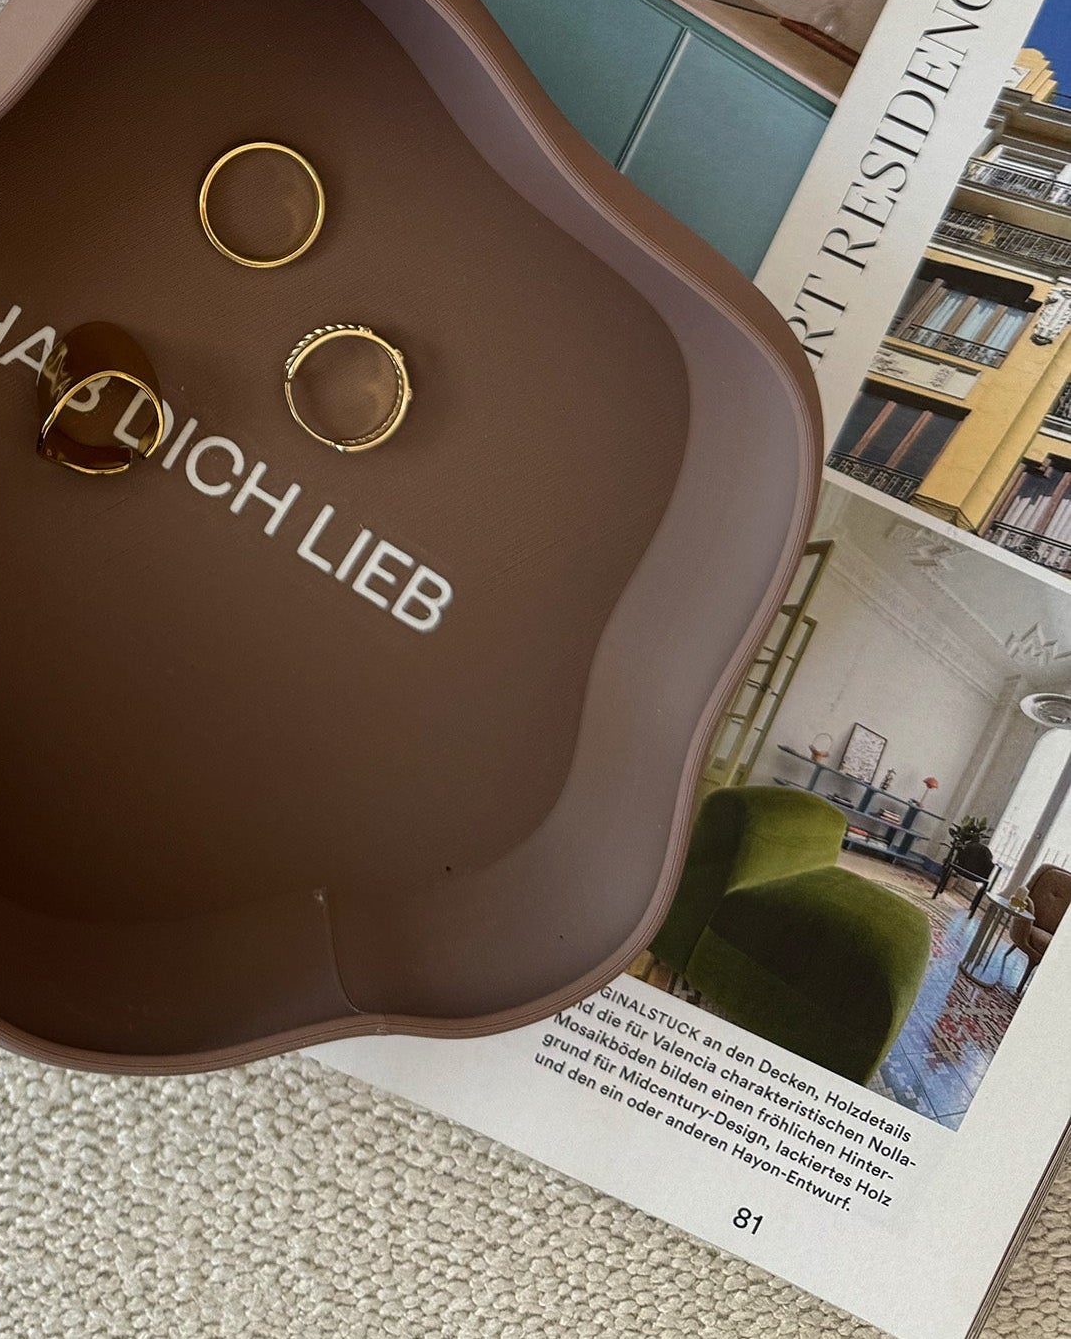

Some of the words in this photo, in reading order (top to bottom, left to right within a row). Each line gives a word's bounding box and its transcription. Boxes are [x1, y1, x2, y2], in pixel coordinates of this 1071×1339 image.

[786, 272, 849, 373] RT
[113, 389, 301, 536] DICH
[297, 504, 454, 632] LIEB
[534, 1052, 566, 1074] und
[567, 1067, 597, 1090] den
[599, 1084, 624, 1102] ein
[626, 1097, 664, 1120] oder
[664, 1115, 728, 1152] anderen
[730, 1142, 851, 1212] Hayon-Entwurf.
[541, 1033, 592, 1062] grund
[592, 1053, 617, 1074] für
[618, 1065, 770, 1151] Midcentury-Design,
[775, 1139, 852, 1187] lackiertes
[854, 1178, 892, 1207] Holz
[553, 1012, 657, 1069] Mosaikböden
[659, 1059, 708, 1094] bilden
[711, 1088, 754, 1116] einen
[756, 1107, 835, 1155] fröhlichen
[837, 1145, 894, 1180] Hinter-
[596, 1008, 621, 1028] die
[624, 1020, 649, 1040] für
[653, 1031, 717, 1074] Valencia
[720, 1068, 864, 1145] charakteristischen
[867, 1135, 916, 1167] Nolla-
[702, 1036, 722, 1052] an
[725, 1045, 755, 1068] den
[757, 1058, 819, 1101] Decken,
[824, 1090, 912, 1142] Holzdetails
[732, 1207, 764, 1236] 81
